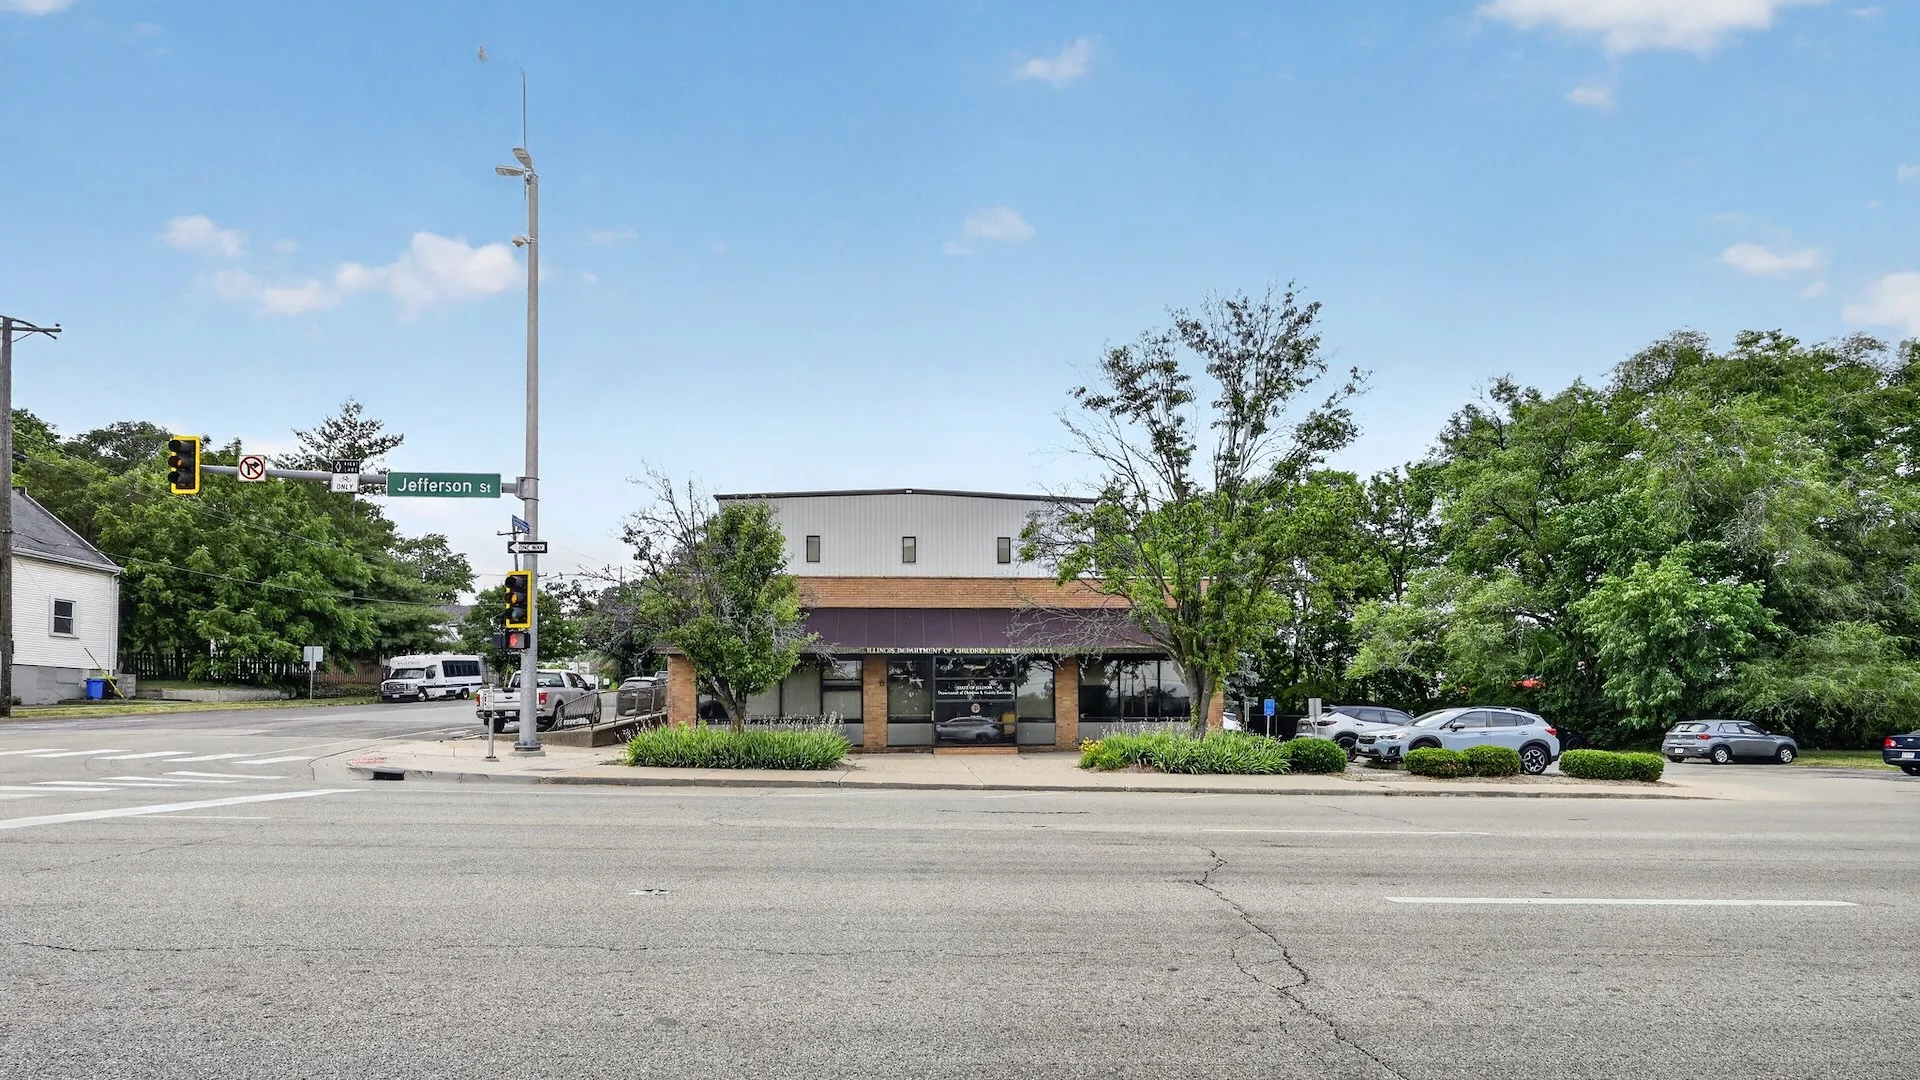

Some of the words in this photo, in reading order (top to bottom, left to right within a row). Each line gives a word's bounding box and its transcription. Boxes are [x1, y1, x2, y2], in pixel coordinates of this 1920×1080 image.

[336, 483, 354, 491] ONLY
[397, 477, 472, 493] Jefferson
[480, 482, 491, 493] St
